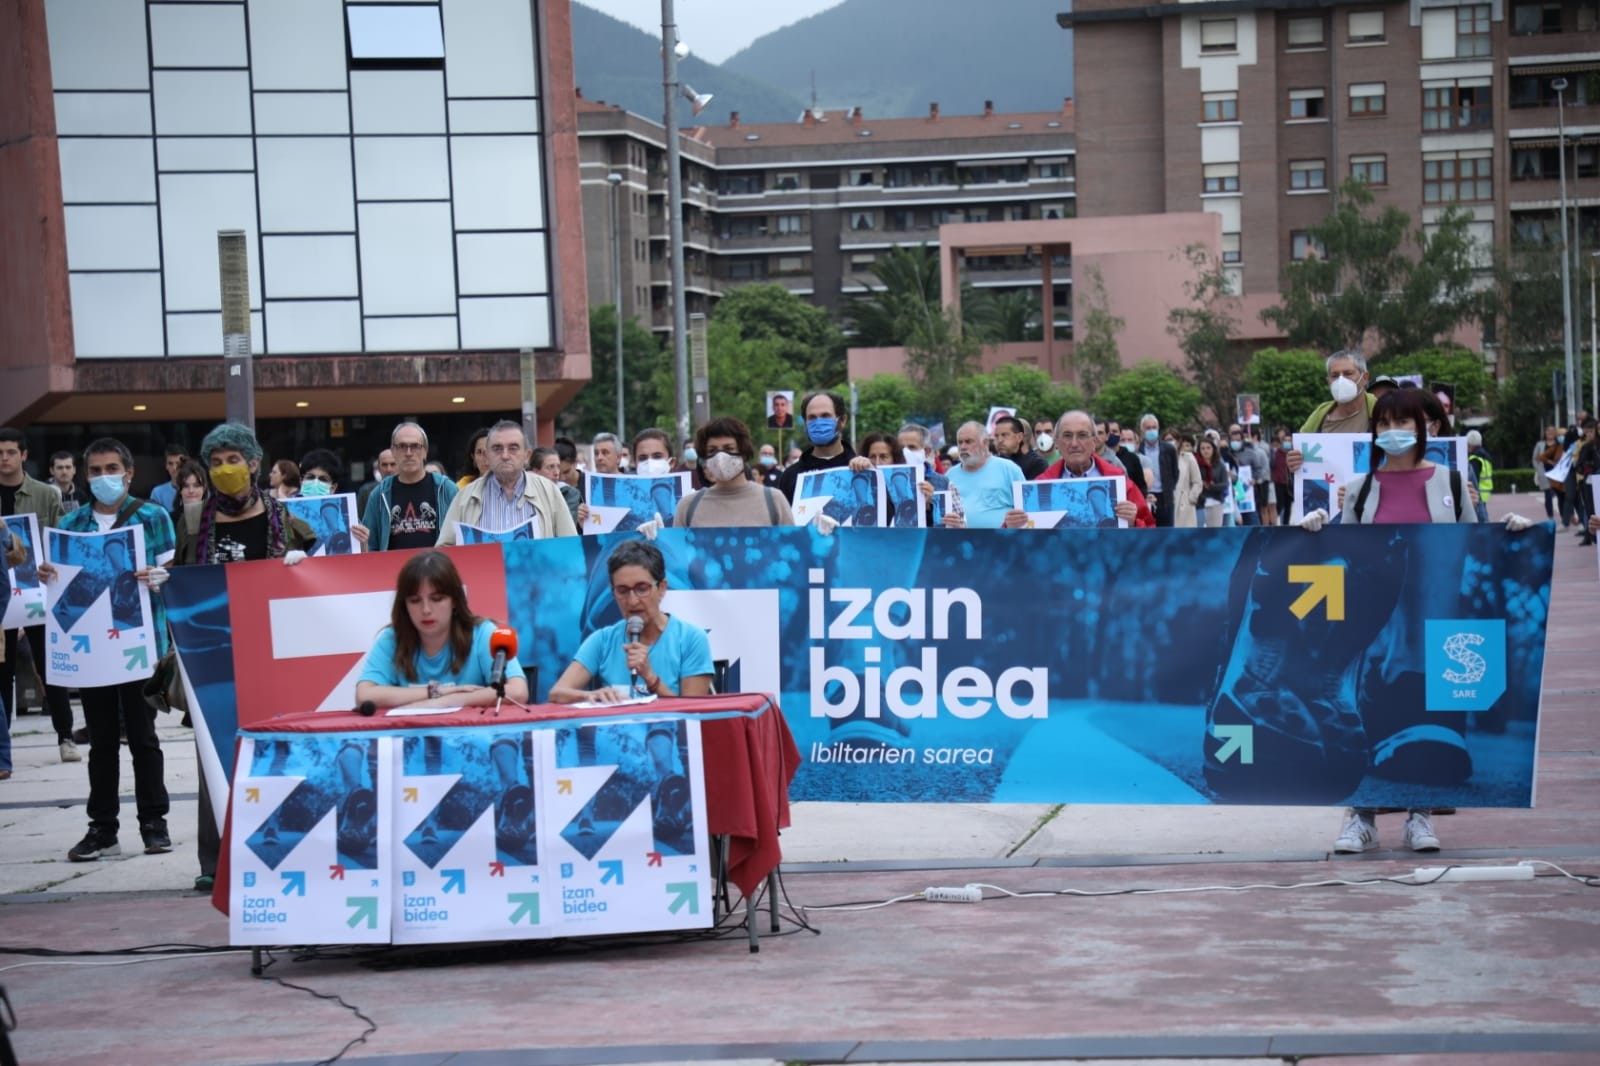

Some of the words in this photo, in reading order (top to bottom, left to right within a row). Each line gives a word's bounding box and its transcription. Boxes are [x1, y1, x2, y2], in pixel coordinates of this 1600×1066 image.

[808, 568, 983, 640] izan
[51, 660, 79, 672] bidea
[809, 646, 1049, 719] bidea
[1452, 689, 1477, 698] SARE
[810, 742, 916, 764] Ibiltarien
[922, 746, 994, 764] sarea
[562, 886, 595, 899] izan
[242, 895, 275, 908] izan
[403, 893, 436, 907] izan
[563, 900, 607, 914] bidea
[242, 909, 287, 923] bidea
[403, 908, 448, 922] bidea
